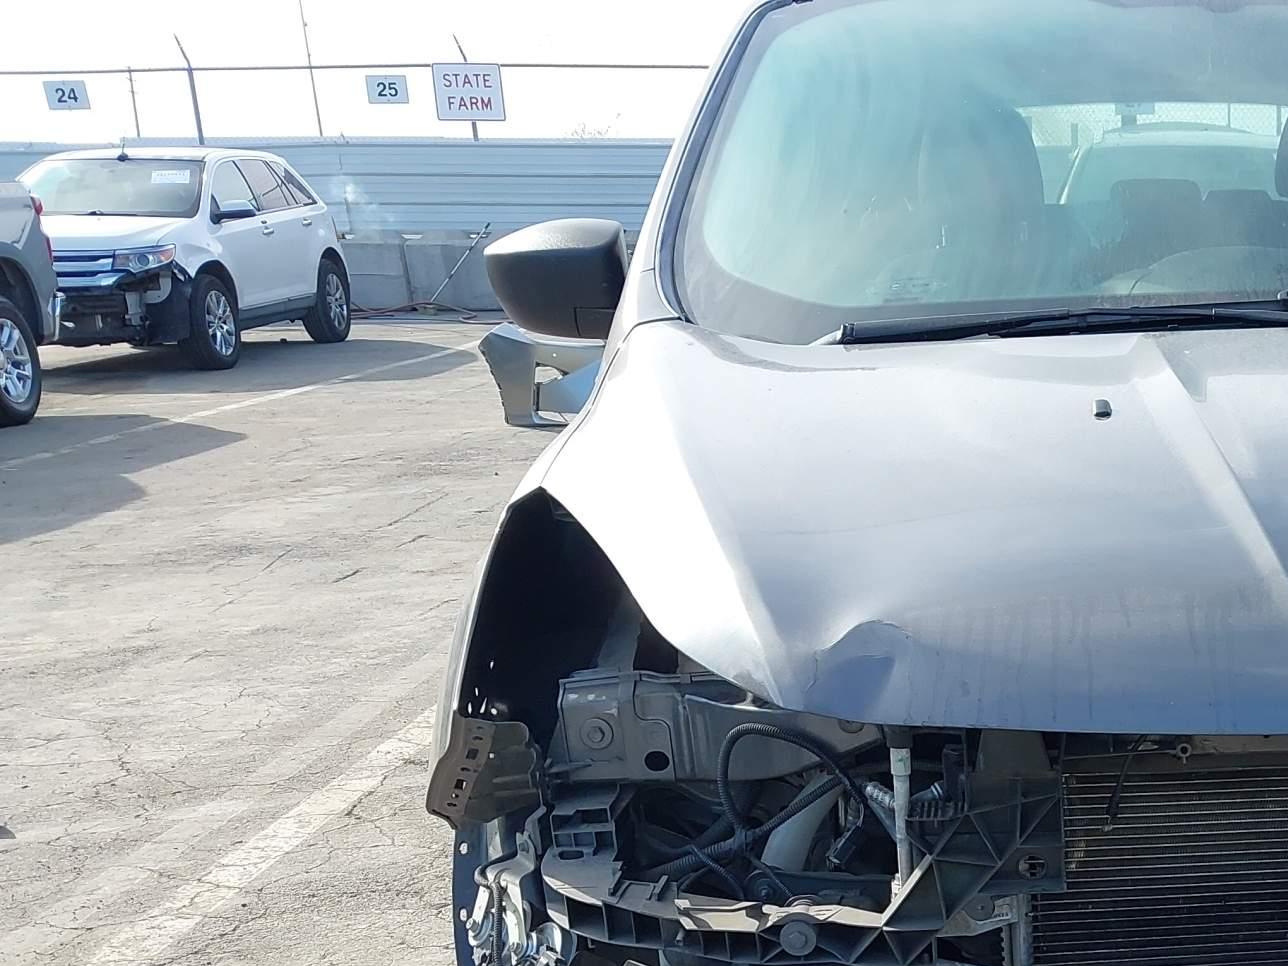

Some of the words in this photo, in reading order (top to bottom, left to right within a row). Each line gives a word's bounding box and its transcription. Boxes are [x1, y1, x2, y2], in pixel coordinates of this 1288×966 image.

[442, 73, 493, 89] STATE
[55, 87, 79, 103] 24
[376, 82, 399, 97] 25
[447, 96, 493, 111] FARM
